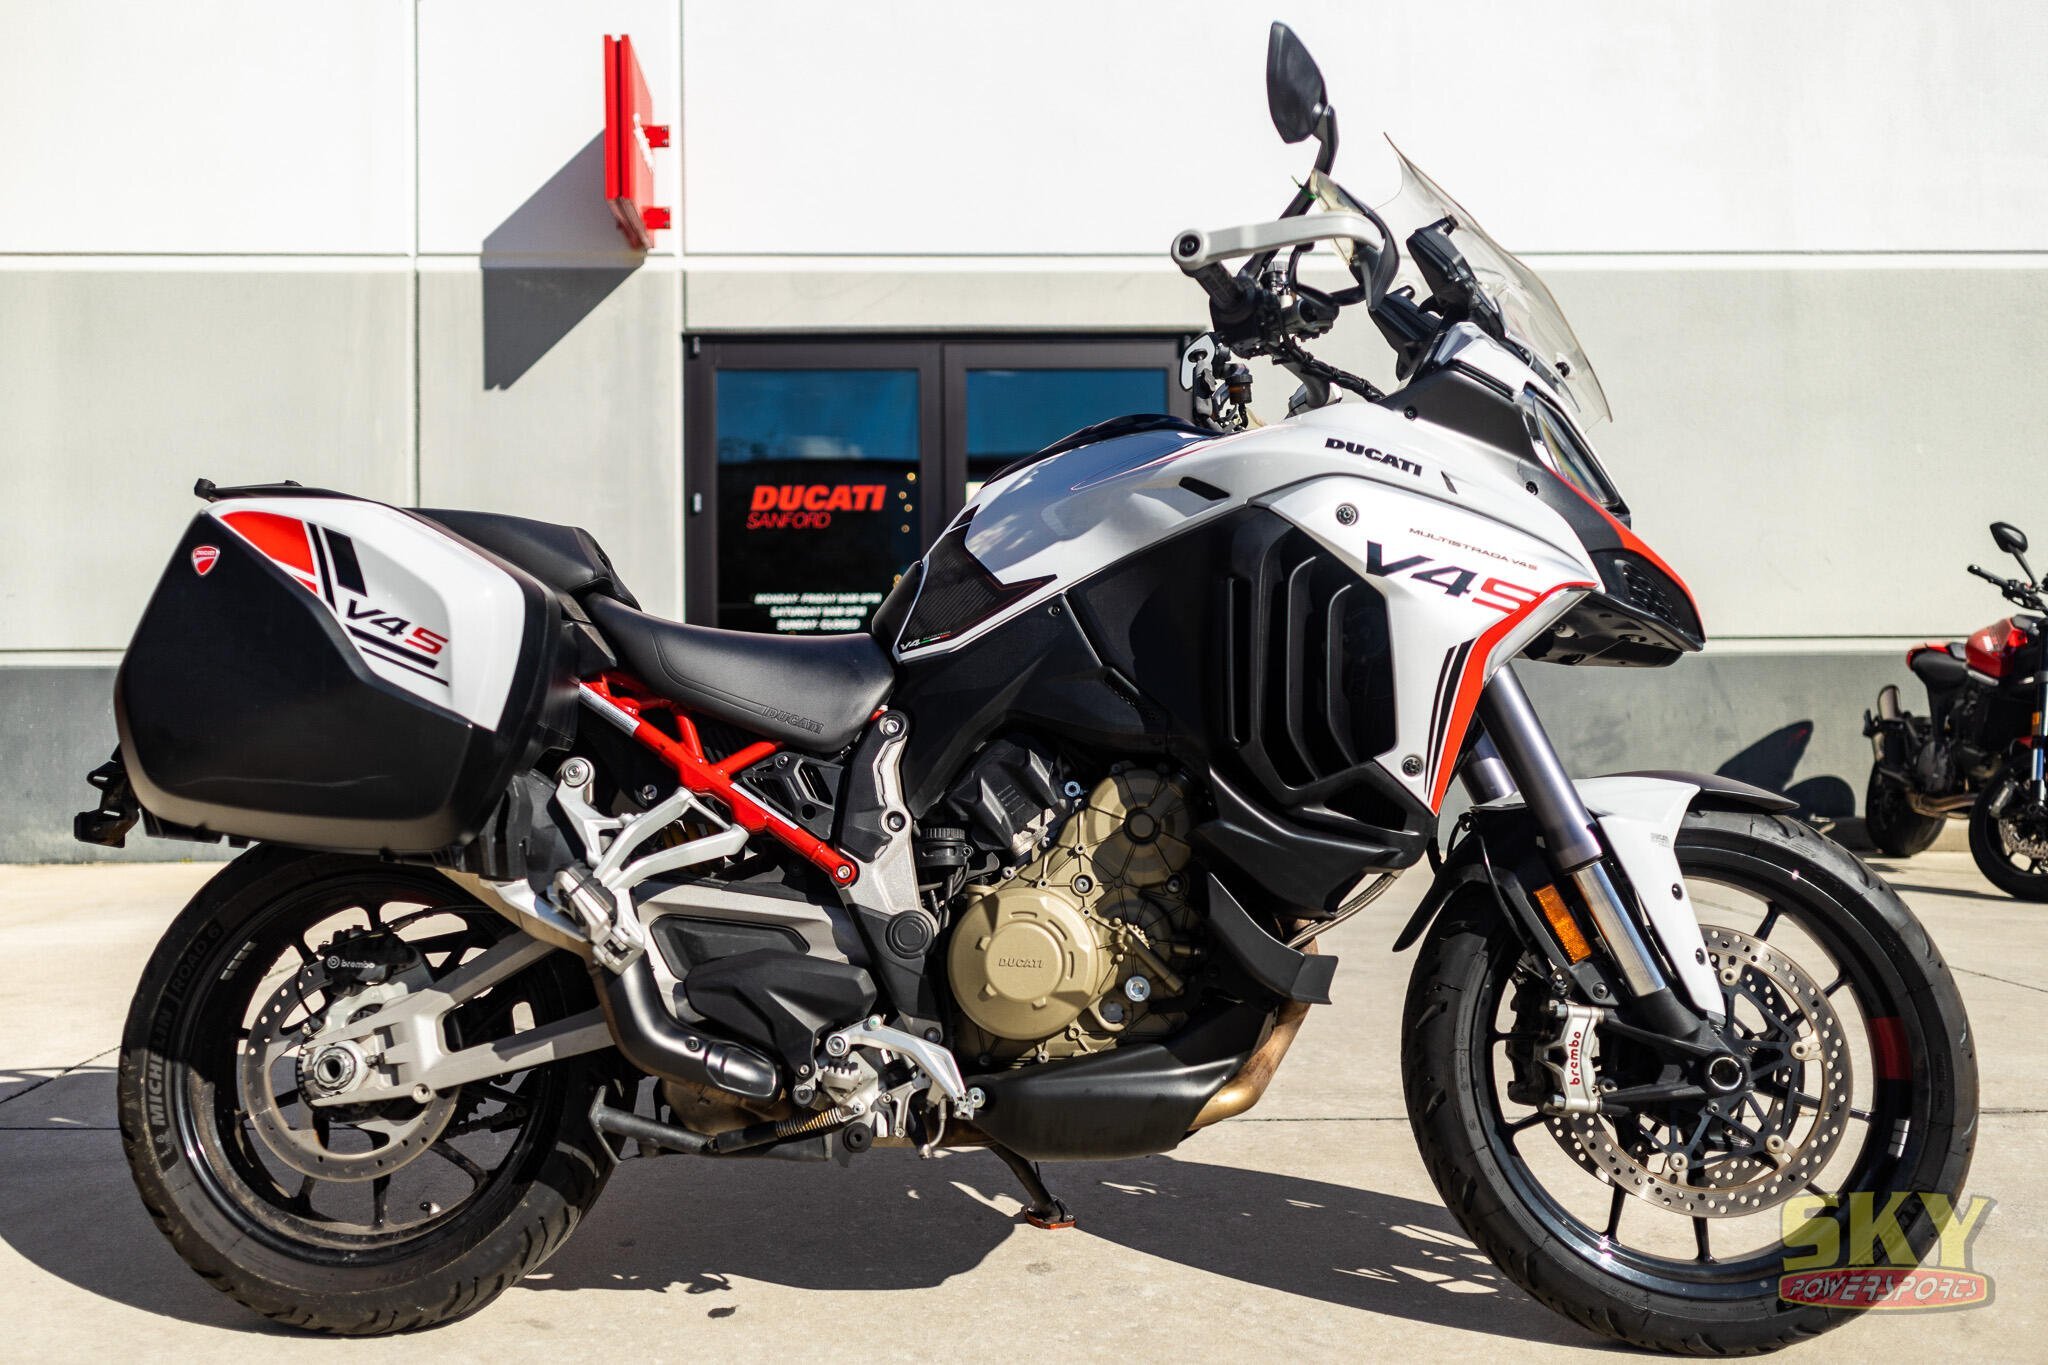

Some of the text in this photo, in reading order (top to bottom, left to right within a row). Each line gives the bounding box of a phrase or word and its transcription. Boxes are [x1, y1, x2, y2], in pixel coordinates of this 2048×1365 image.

[1325, 438, 1422, 477] DUCATI
[750, 485, 887, 511] DUCATI
[747, 511, 831, 529] SANFORD
[1409, 527, 1508, 562] MULTISTRADA
[1365, 540, 1544, 614] V4S
[347, 599, 449, 655] V4S
[900, 639, 921, 651] V4
[766, 706, 824, 735] DUCATI
[171, 939, 209, 993] ROAD
[341, 959, 375, 969] brembo
[998, 957, 1043, 969] DUCATI
[147, 1008, 174, 1126] MICHELIN
[1569, 1031, 1581, 1086] brembo
